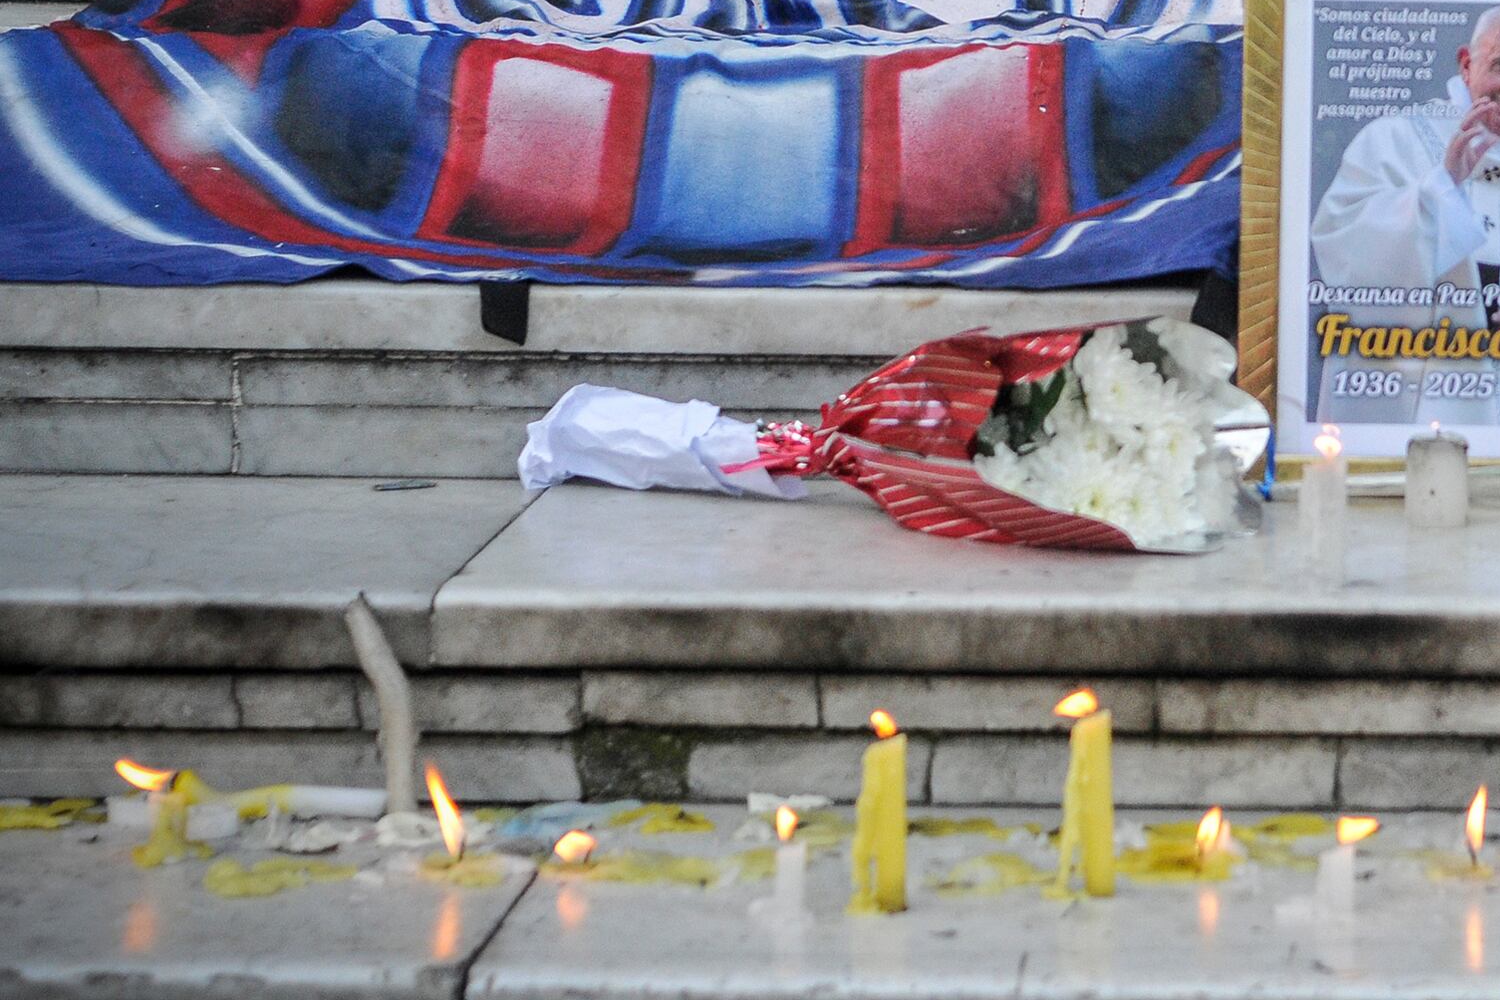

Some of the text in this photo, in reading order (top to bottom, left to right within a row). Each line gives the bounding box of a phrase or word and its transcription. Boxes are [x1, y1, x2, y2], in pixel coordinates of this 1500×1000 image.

[1373, 7, 1469, 25] ciudadanos
[1333, 25, 1437, 45] del Cielo, y el
[1326, 45, 1438, 66] amor a Dios y
[1328, 63, 1434, 83] al prójimo es
[1348, 86, 1412, 101] nuestro
[1316, 102, 1401, 121] pasaporte
[1401, 102, 1418, 117] al
[1308, 279, 1406, 307] Descansa
[1408, 287, 1434, 306] en
[1436, 281, 1477, 308] Paz
[1332, 369, 1402, 396] 1936
[1424, 370, 1497, 398] 2025
